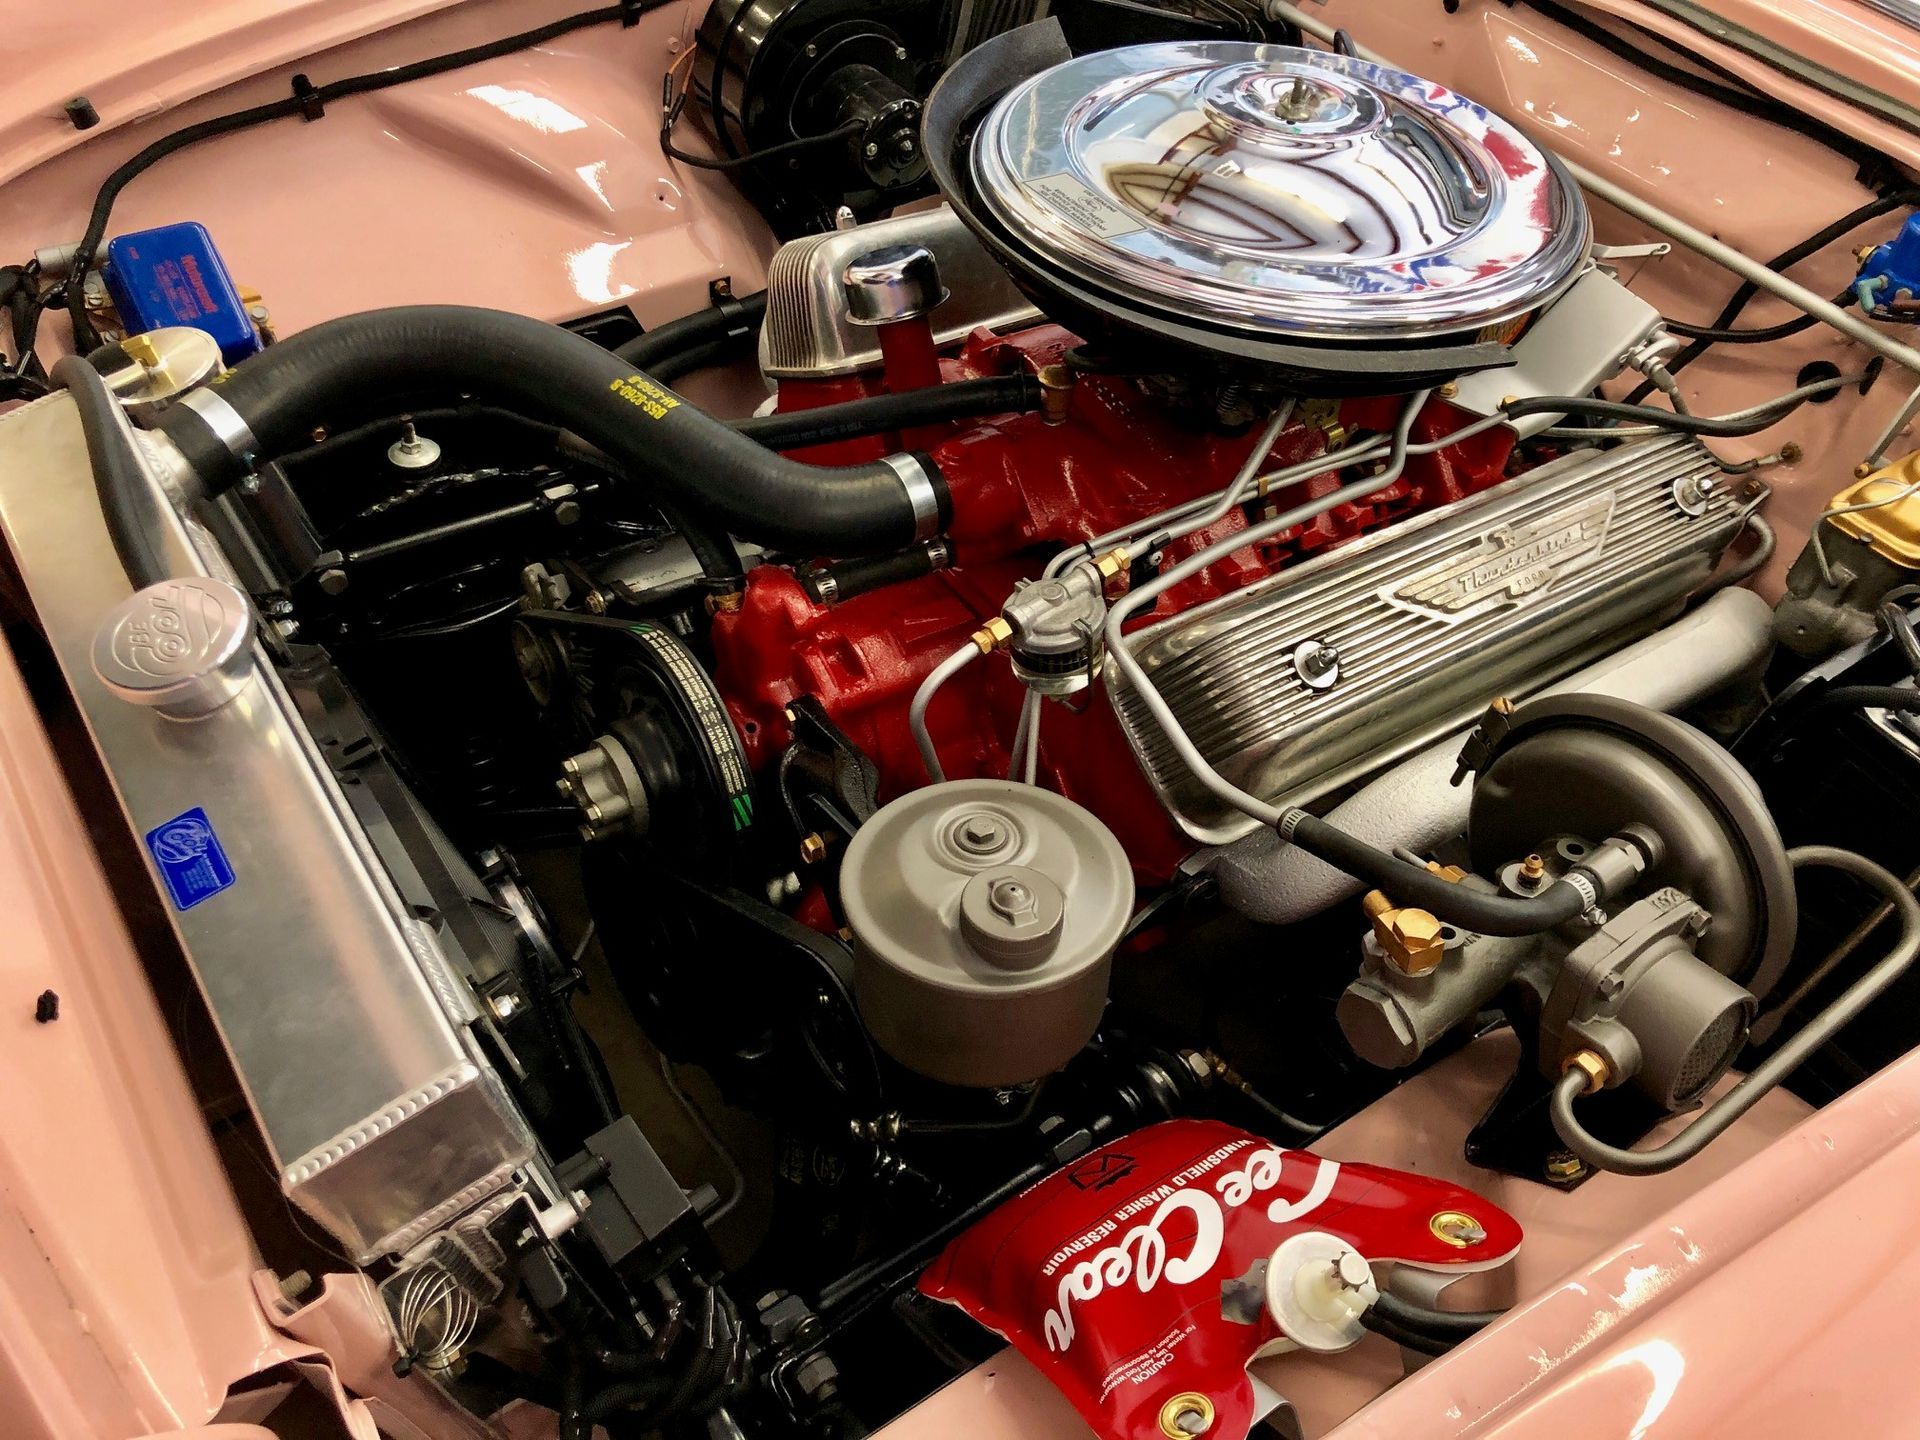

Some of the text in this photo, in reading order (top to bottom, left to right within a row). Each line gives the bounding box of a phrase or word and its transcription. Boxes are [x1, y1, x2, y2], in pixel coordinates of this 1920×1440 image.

[1172, 1140, 1255, 1187] WINDSHIELD
[1115, 1185, 1176, 1220] WASHER
[1043, 1220, 1117, 1275] RESERVOIR
[1156, 1329, 1182, 1348] Solution
[1164, 1333, 1186, 1349] Winter
[1186, 1325, 1196, 1333] For
[1102, 1354, 1149, 1387] Recommended
[1125, 1364, 1141, 1377] Ford
[1131, 1353, 1174, 1384] CAUTION
[1140, 1356, 1154, 1369] Add
